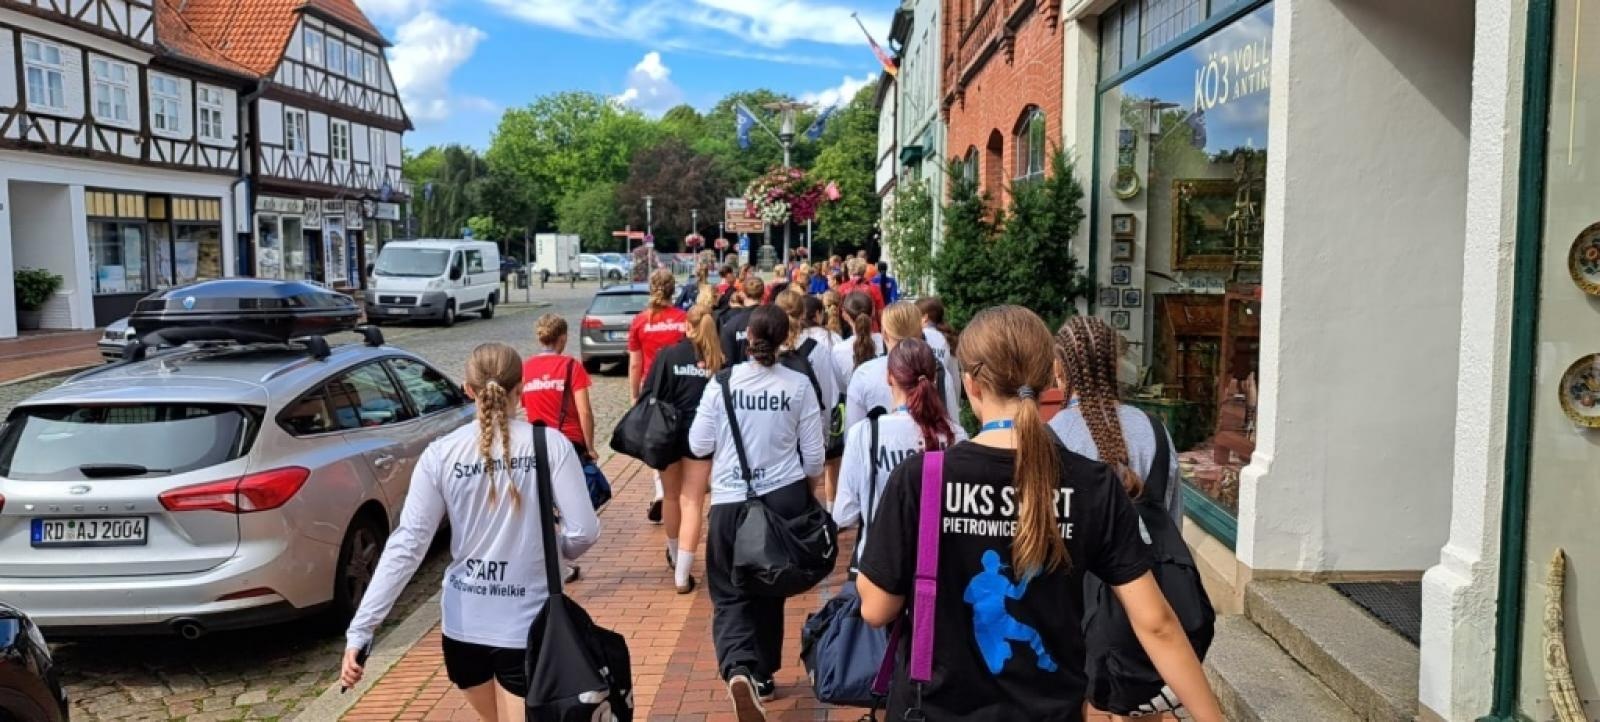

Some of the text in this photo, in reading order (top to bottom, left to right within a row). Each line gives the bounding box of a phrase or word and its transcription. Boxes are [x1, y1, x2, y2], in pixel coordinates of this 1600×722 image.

[1194, 52, 1229, 113] KÖ3
[732, 466, 765, 480] SRT
[946, 481, 1075, 518] UKS SRT
[44, 519, 143, 541] RD AJ 2004
[943, 516, 1018, 537] PIETROWICE
[489, 583, 526, 598] Wielkie
